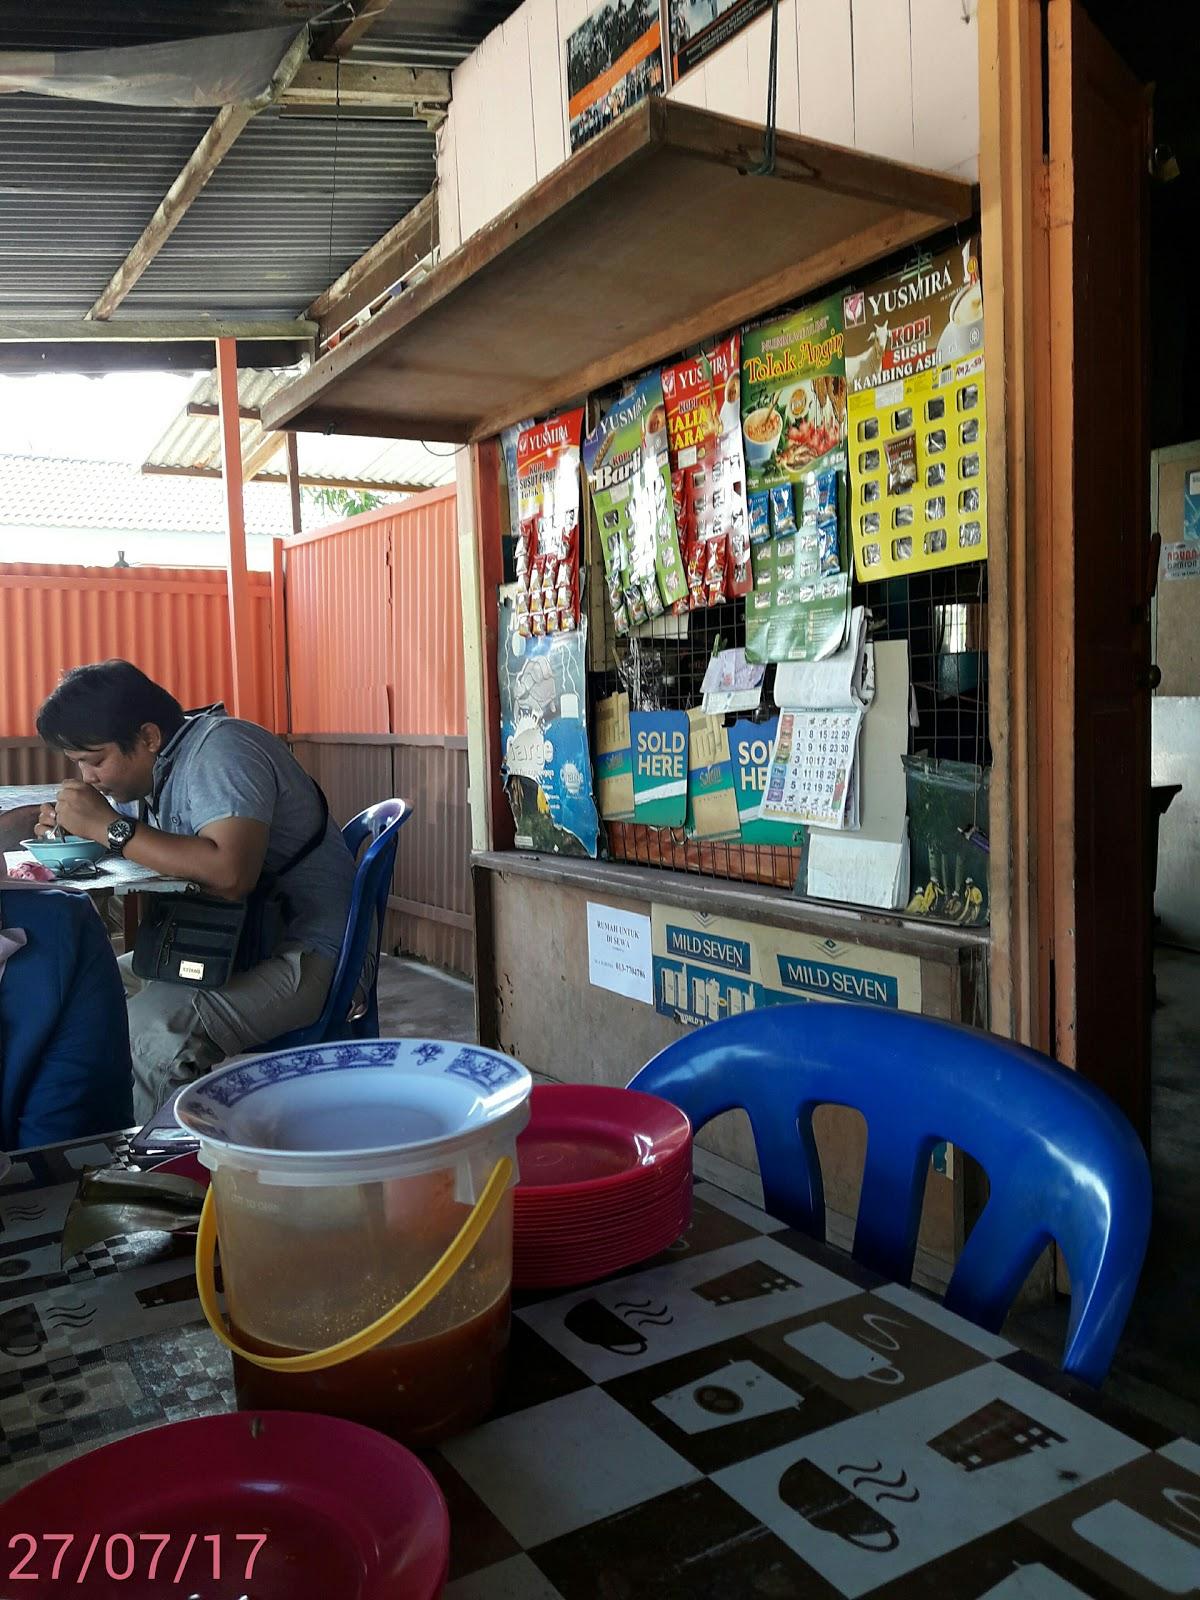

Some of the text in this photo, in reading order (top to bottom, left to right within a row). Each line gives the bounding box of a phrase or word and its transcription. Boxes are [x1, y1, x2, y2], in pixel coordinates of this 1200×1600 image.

[868, 265, 952, 316] YUSMIRA
[890, 315, 931, 350] KOPI
[743, 348, 796, 384] Tolak
[798, 328, 844, 368] Angin
[679, 354, 728, 389] YUSIRA
[854, 362, 912, 392] KAMBING
[600, 393, 647, 434] YUSMIRA
[530, 424, 568, 451] YUSMIRA
[520, 475, 538, 490] SUSUT
[638, 731, 686, 753] SOLD
[808, 743, 812, 751] 9
[818, 744, 826, 752] 16
[829, 744, 838, 752] 23
[840, 744, 848, 752] 30
[819, 730, 827, 738] 15
[830, 730, 838, 738] 22
[841, 730, 850, 740] 29
[638, 754, 684, 778] HERE
[792, 767, 797, 776] 4
[804, 769, 811, 778] 11
[794, 755, 800, 764] 3
[805, 756, 813, 764] 10
[816, 757, 825, 765] 17
[828, 757, 836, 766] 24
[790, 780, 796, 789] 5
[802, 782, 811, 790] 12
[814, 782, 822, 791] 19
[825, 783, 833, 792] 26
[620, 926, 640, 940] UNTUK
[672, 932, 742, 965] MILD SEVEN
[788, 963, 887, 1002] MILD SEVEN
